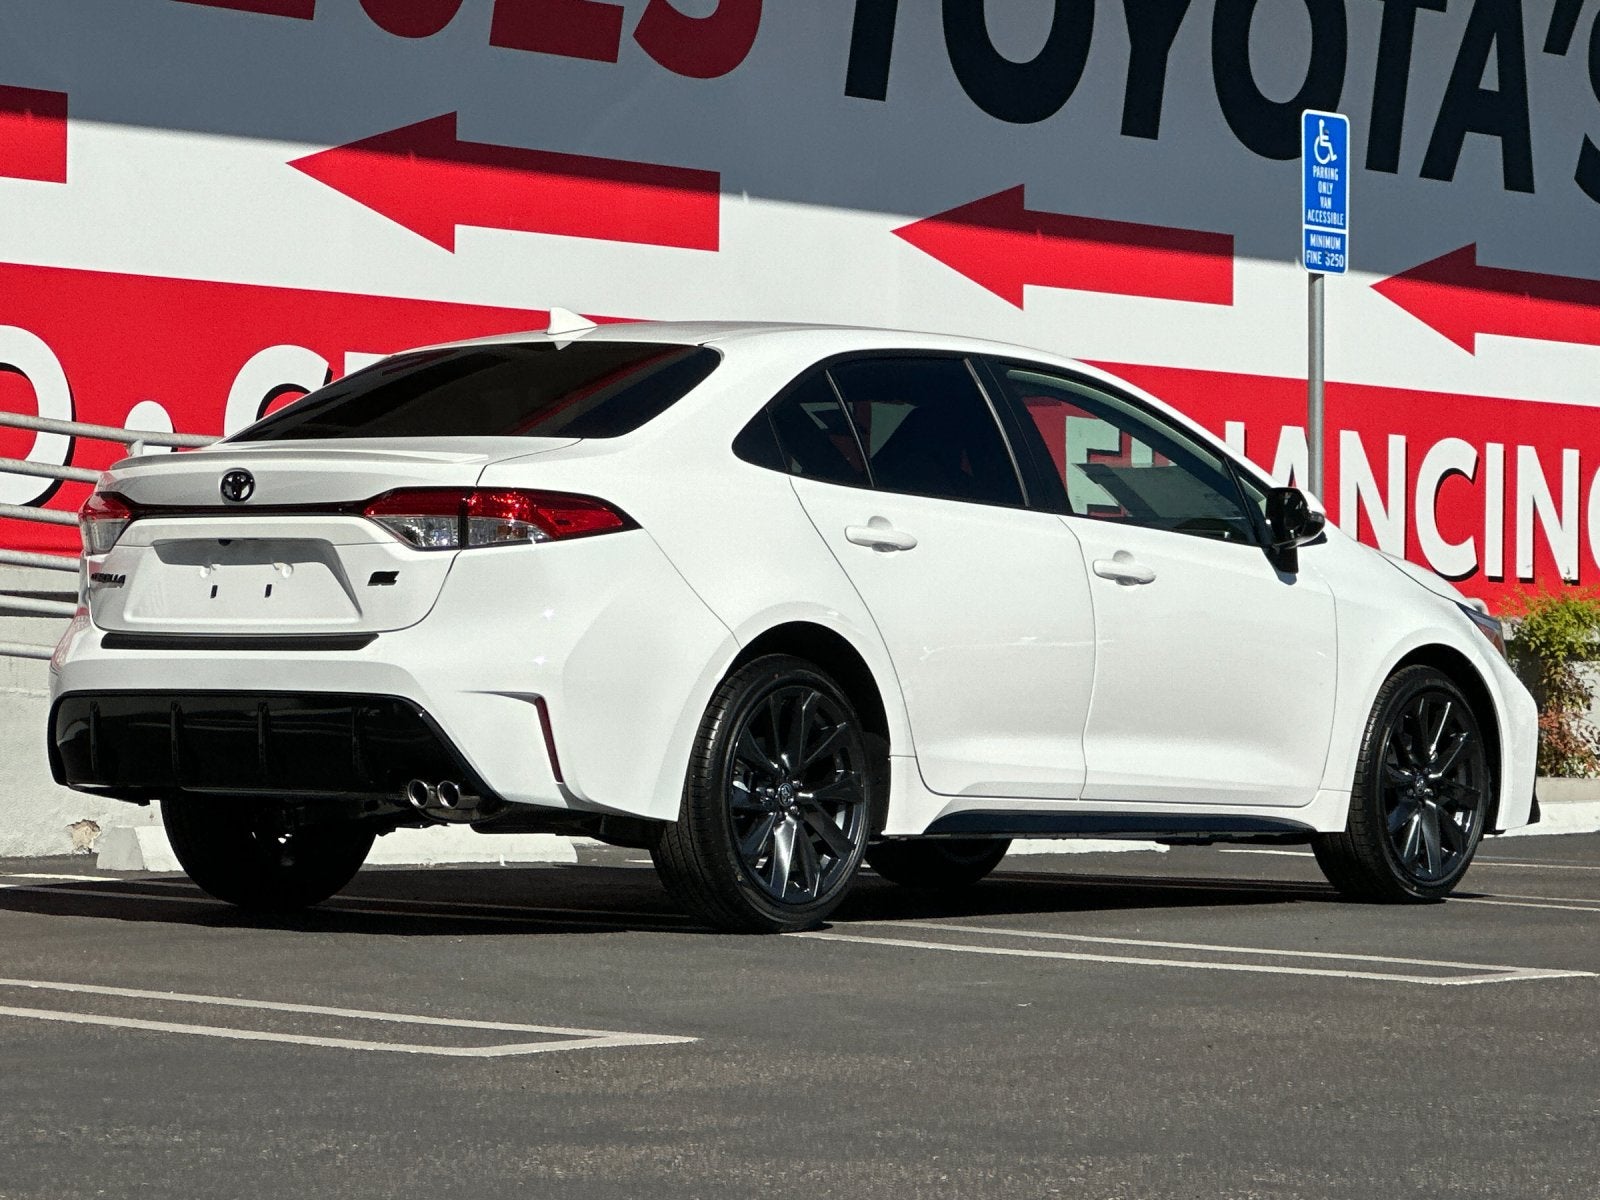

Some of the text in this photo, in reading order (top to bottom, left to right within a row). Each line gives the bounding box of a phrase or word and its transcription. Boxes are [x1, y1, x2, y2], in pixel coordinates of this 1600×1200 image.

[845, 0, 1600, 207] OYOTA'
[1312, 165, 1338, 181] PARKING
[1318, 181, 1333, 194] ONLY
[1320, 196, 1331, 209] VAN
[1307, 209, 1344, 225] ACCESSIBLE
[1310, 234, 1341, 250] MINIMUM
[1306, 250, 1344, 267] FINE $250
[1066, 416, 1600, 580] FNCIN
